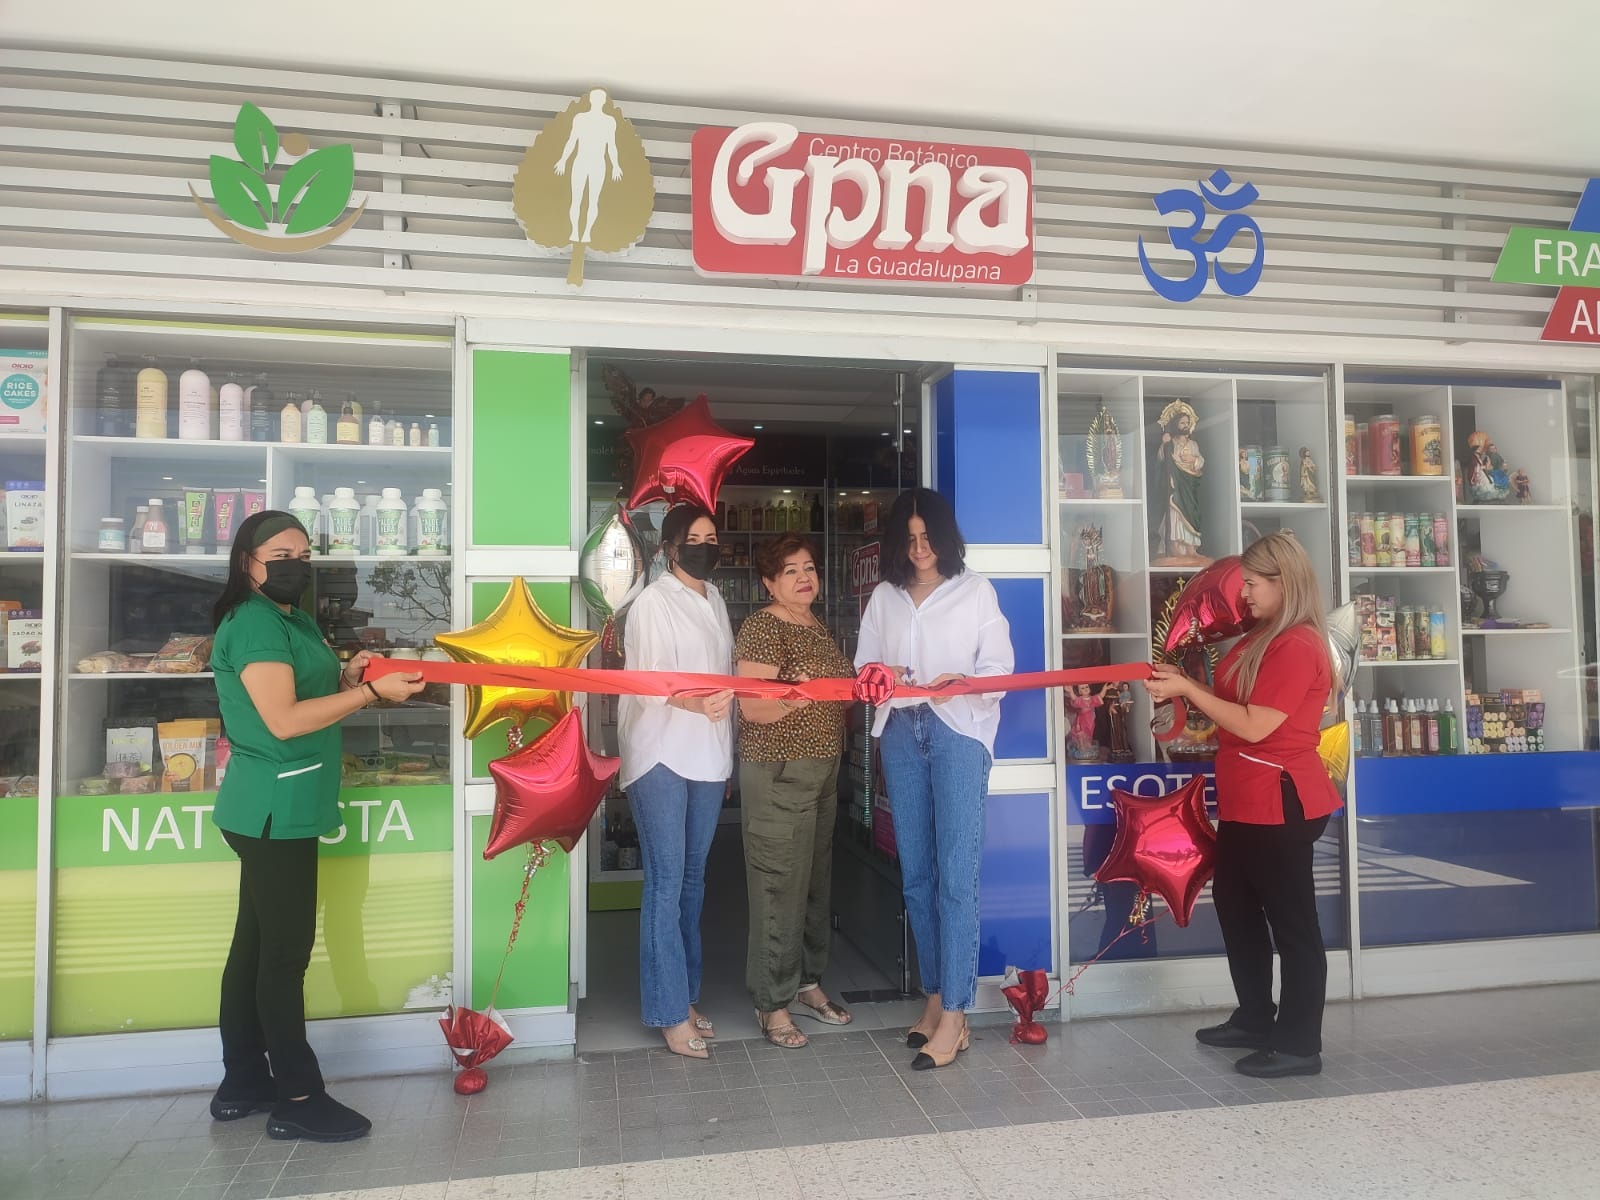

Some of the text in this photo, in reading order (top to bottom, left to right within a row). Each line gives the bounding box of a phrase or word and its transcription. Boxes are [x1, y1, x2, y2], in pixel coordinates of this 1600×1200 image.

[809, 137, 978, 169] Centro Botánico
[710, 122, 1030, 276] Gpna
[834, 254, 1001, 283] La Guadalupana
[1570, 299, 1600, 335] A
[7, 382, 33, 390] RICE
[102, 799, 415, 852] NATSTA
